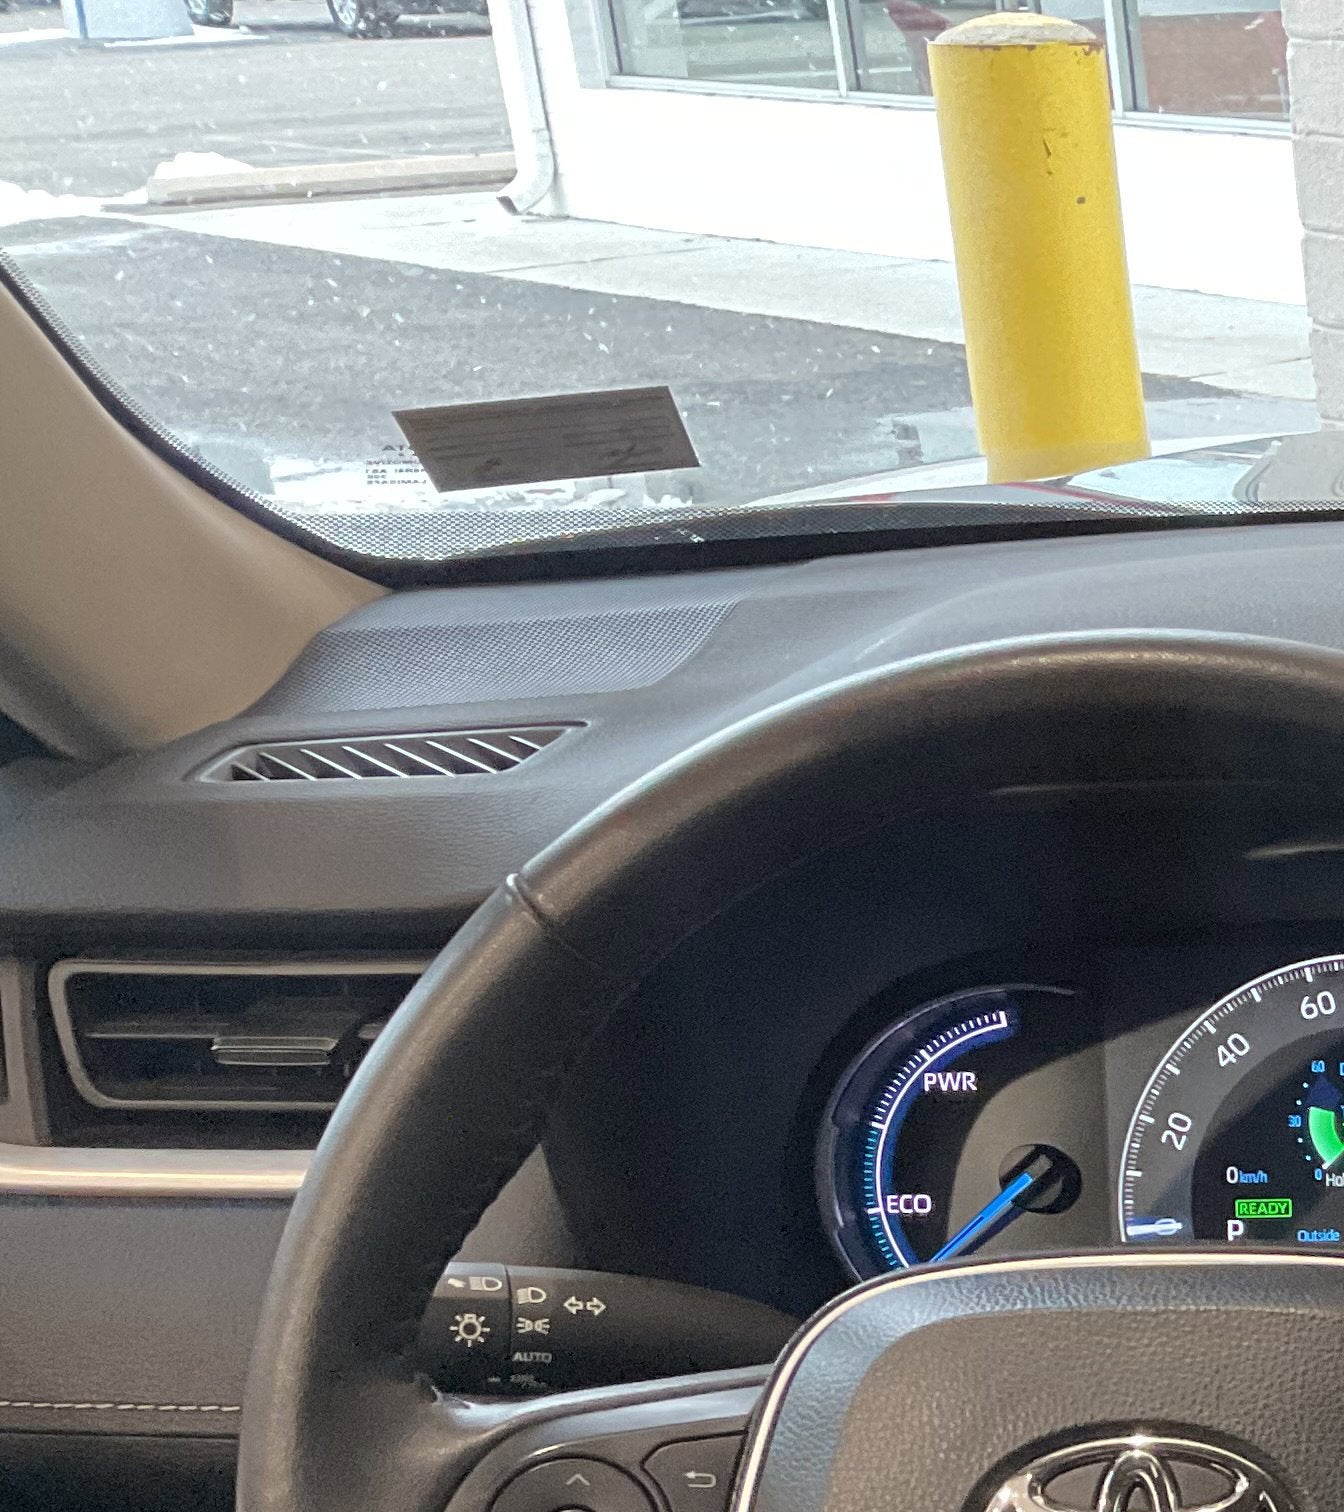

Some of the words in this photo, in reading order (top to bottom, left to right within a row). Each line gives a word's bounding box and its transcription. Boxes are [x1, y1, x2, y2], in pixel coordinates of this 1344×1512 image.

[1299, 990, 1336, 1020] 60
[1216, 1032, 1251, 1067] 40
[1310, 1060, 1326, 1073] 60
[923, 1071, 978, 1092] PWR
[1287, 1114, 1302, 1128] 30
[1161, 1112, 1192, 1151] 20
[1226, 1166, 1238, 1184] 0
[1239, 1169, 1268, 1184] km/h
[1314, 1168, 1323, 1181] 0
[886, 1194, 932, 1214] ECO
[1238, 1201, 1288, 1216] READY
[1226, 1219, 1245, 1241] P
[1297, 1229, 1341, 1242] Outside
[512, 1351, 552, 1364] AUTO
